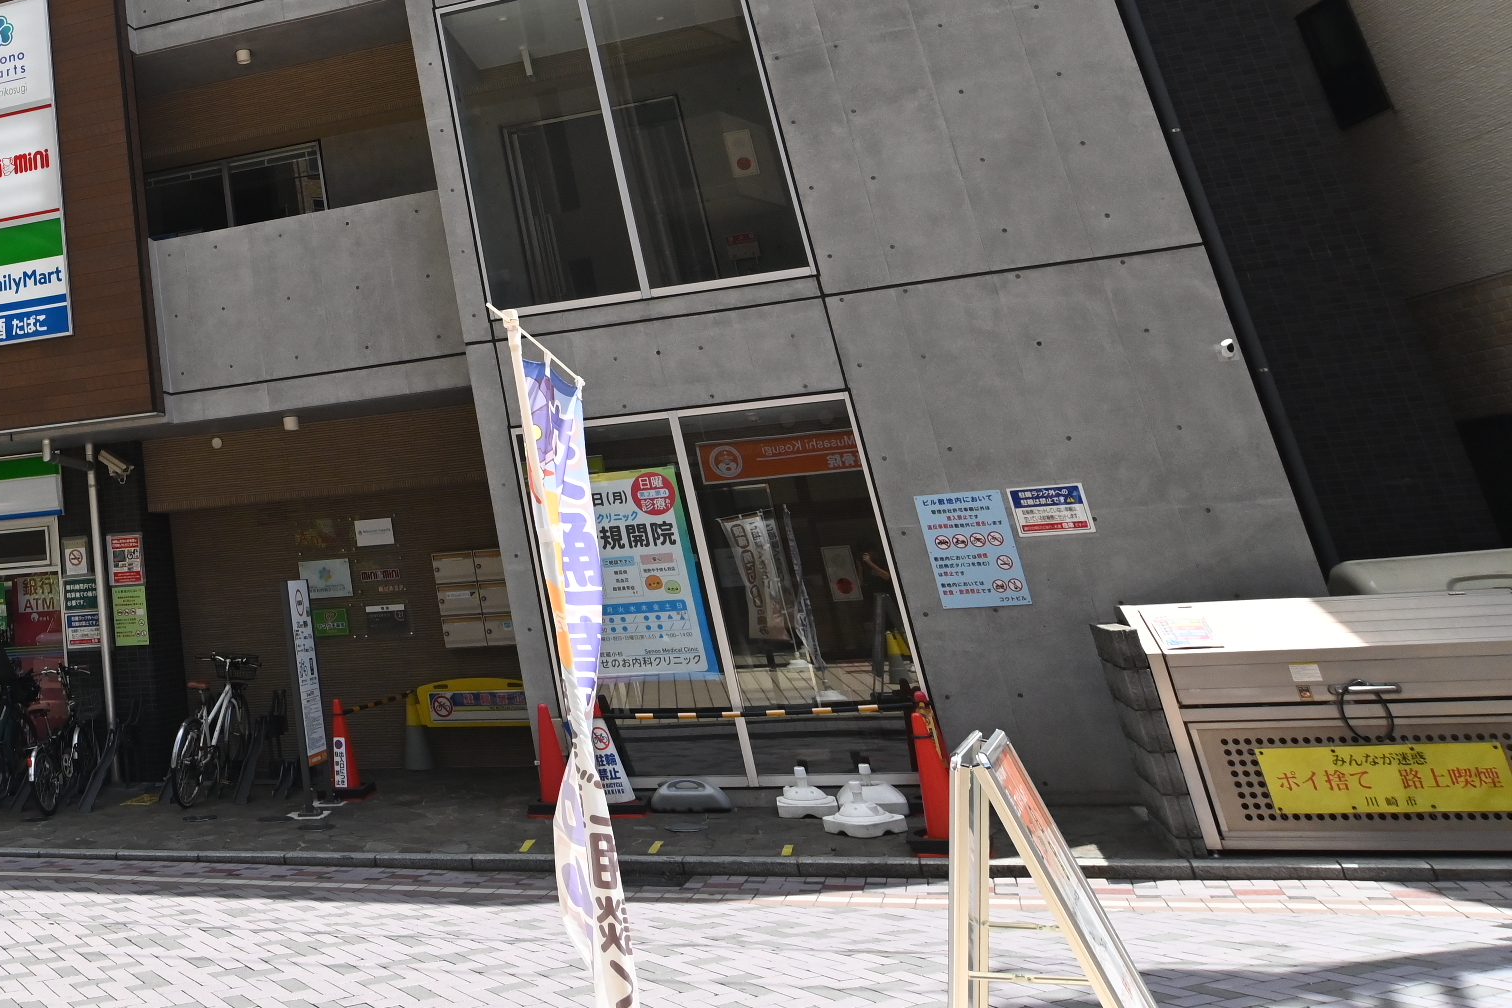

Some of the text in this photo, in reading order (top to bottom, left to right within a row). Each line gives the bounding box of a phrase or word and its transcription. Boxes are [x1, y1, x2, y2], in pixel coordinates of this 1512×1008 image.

[13, 148, 50, 175] mini
[12, 314, 47, 335] たばこ
[638, 475, 664, 489] 日曜
[922, 494, 993, 506] ビル敷地内において
[1018, 488, 1069, 499] 駐輪ラック外への
[1020, 496, 1066, 506] 駐輪は禁止です
[596, 510, 638, 524] クリニック
[597, 520, 677, 551] 規開院
[21, 575, 55, 597] 銀行
[940, 580, 985, 589] 敷地内においては
[23, 597, 56, 612] ATM
[999, 595, 1027, 603] コウトビル
[601, 654, 701, 669] せのお内科クリニック
[1331, 750, 1428, 768] みんなが迷惑
[1276, 765, 1505, 792] ポイ捨て 路上喫煙
[1364, 795, 1418, 808] 川崎市
